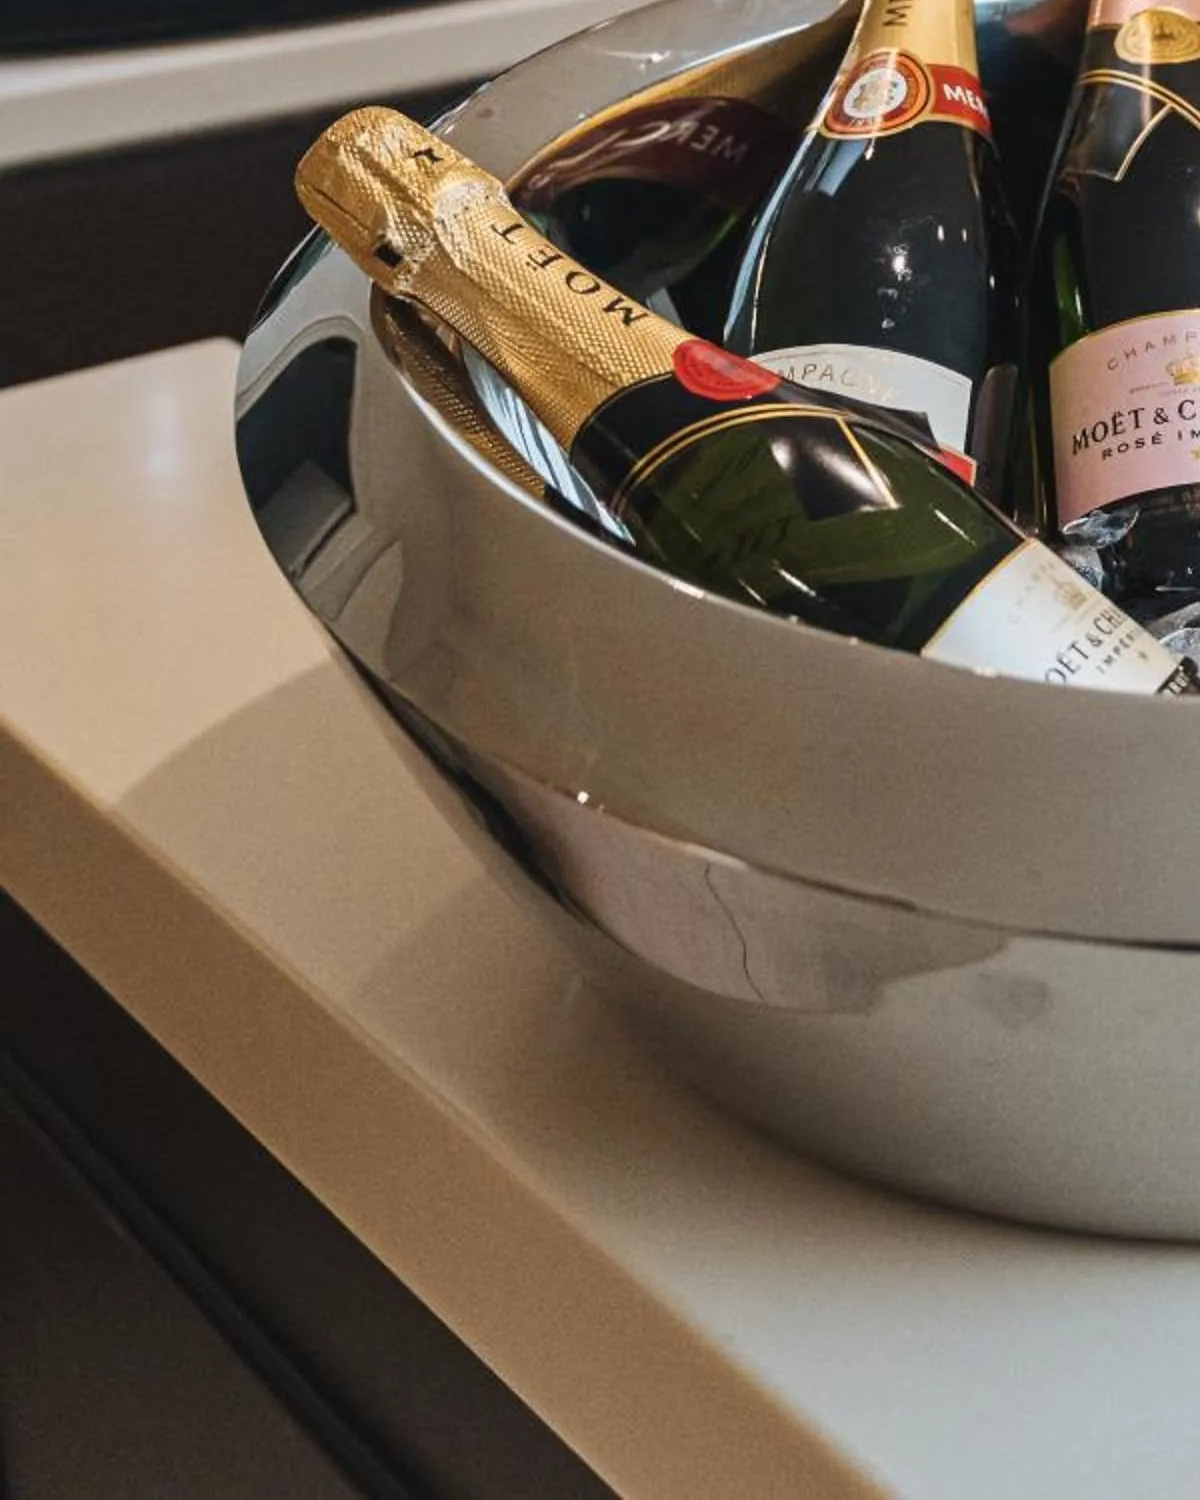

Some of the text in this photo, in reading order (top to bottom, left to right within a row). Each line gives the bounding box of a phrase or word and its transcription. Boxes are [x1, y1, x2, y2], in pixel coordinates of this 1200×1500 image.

[492, 222, 651, 328] MOËT
[1071, 406, 1146, 457] MOËT
[1152, 406, 1170, 426] &
[1101, 430, 1163, 461] ROSÉ
